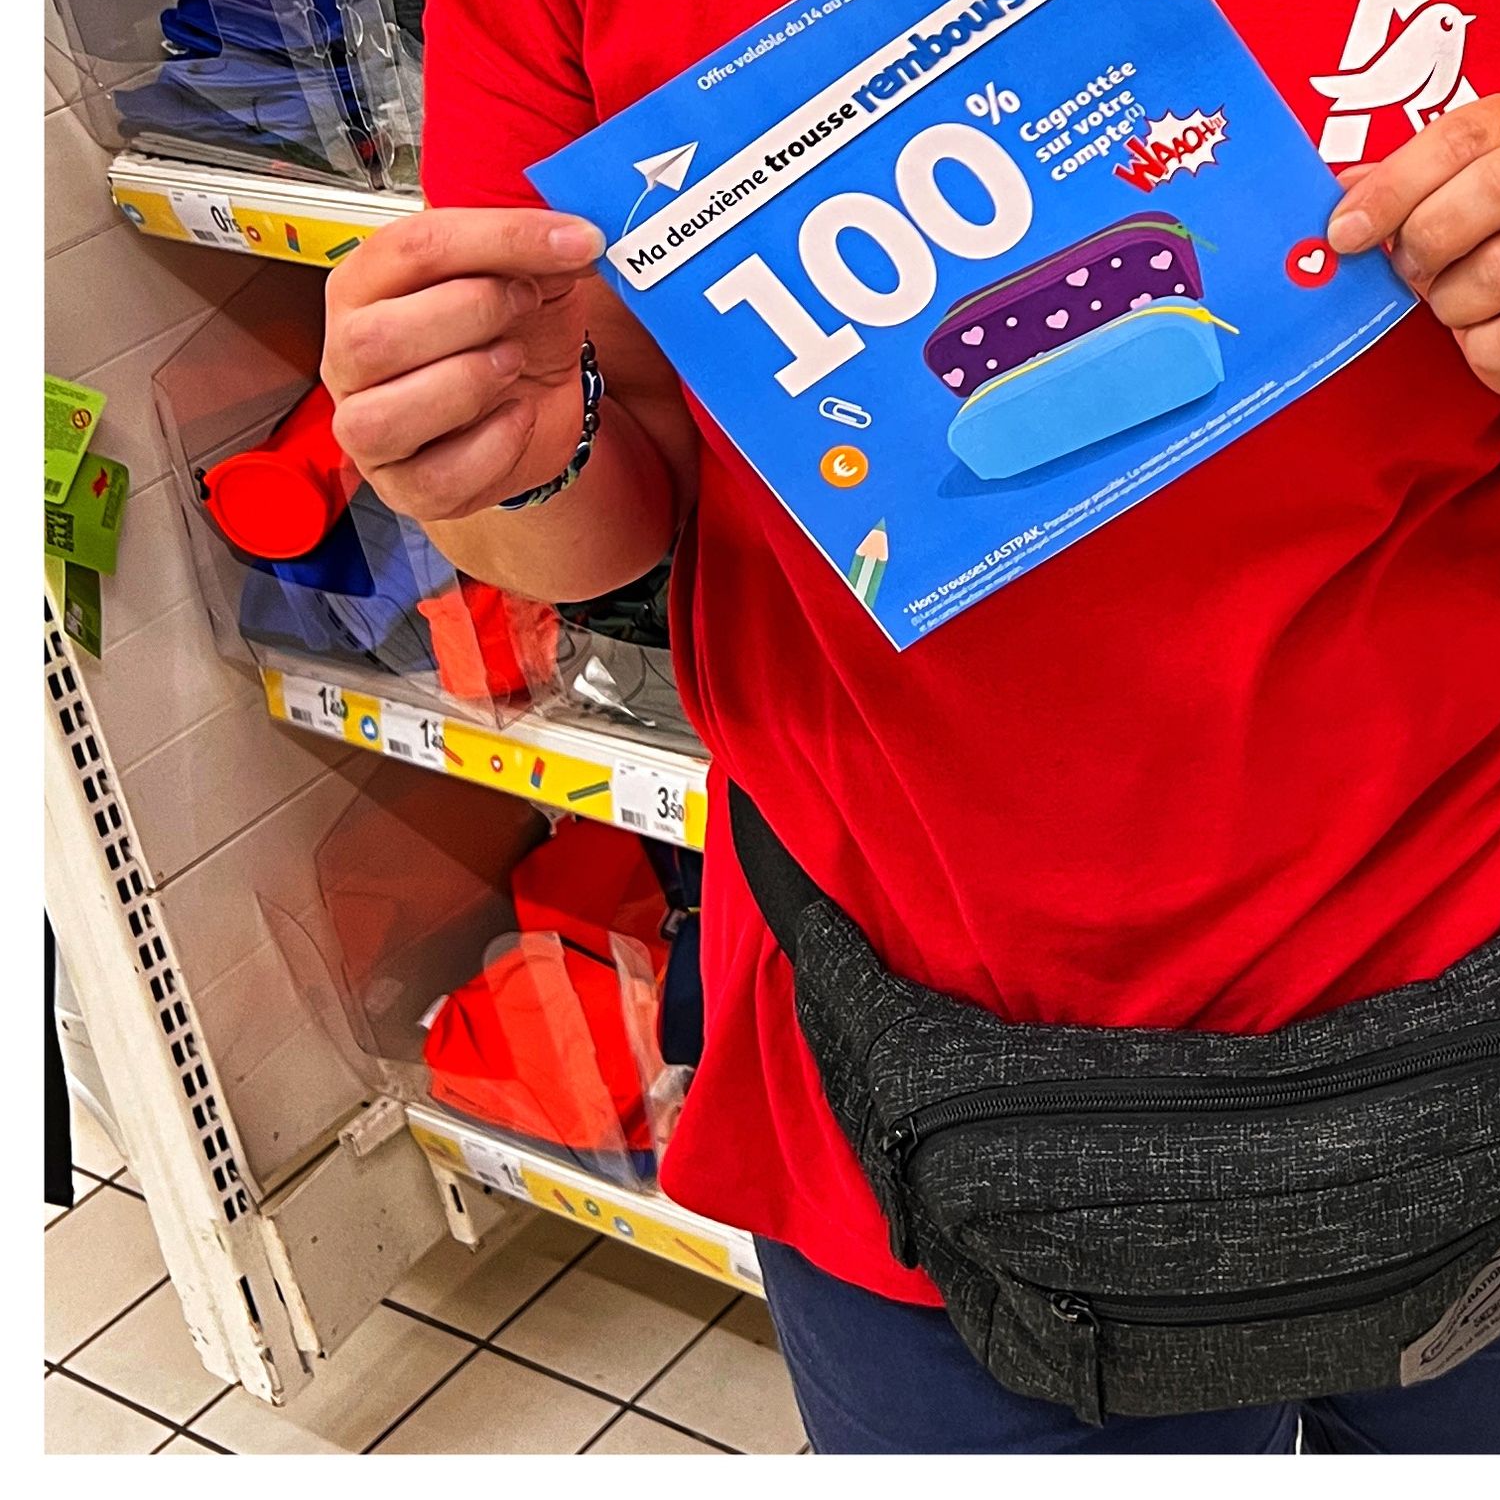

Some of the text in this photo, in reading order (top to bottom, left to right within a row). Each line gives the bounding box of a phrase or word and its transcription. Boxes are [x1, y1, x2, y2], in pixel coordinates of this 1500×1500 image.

[696, 60, 736, 91] Offre
[733, 29, 787, 68] valable
[785, 20, 806, 38] du
[803, 6, 823, 27] 14
[1019, 61, 1136, 142] Cagnottée
[1035, 89, 1135, 163] sur votre
[625, 238, 668, 276] Ma
[665, 167, 769, 246] deuxième
[763, 102, 859, 174] trousse
[703, 122, 1033, 398] 100
[965, 81, 1021, 125] %
[909, 587, 940, 613] Hors
[938, 560, 989, 595] trousses
[657, 786, 669, 818] 3
